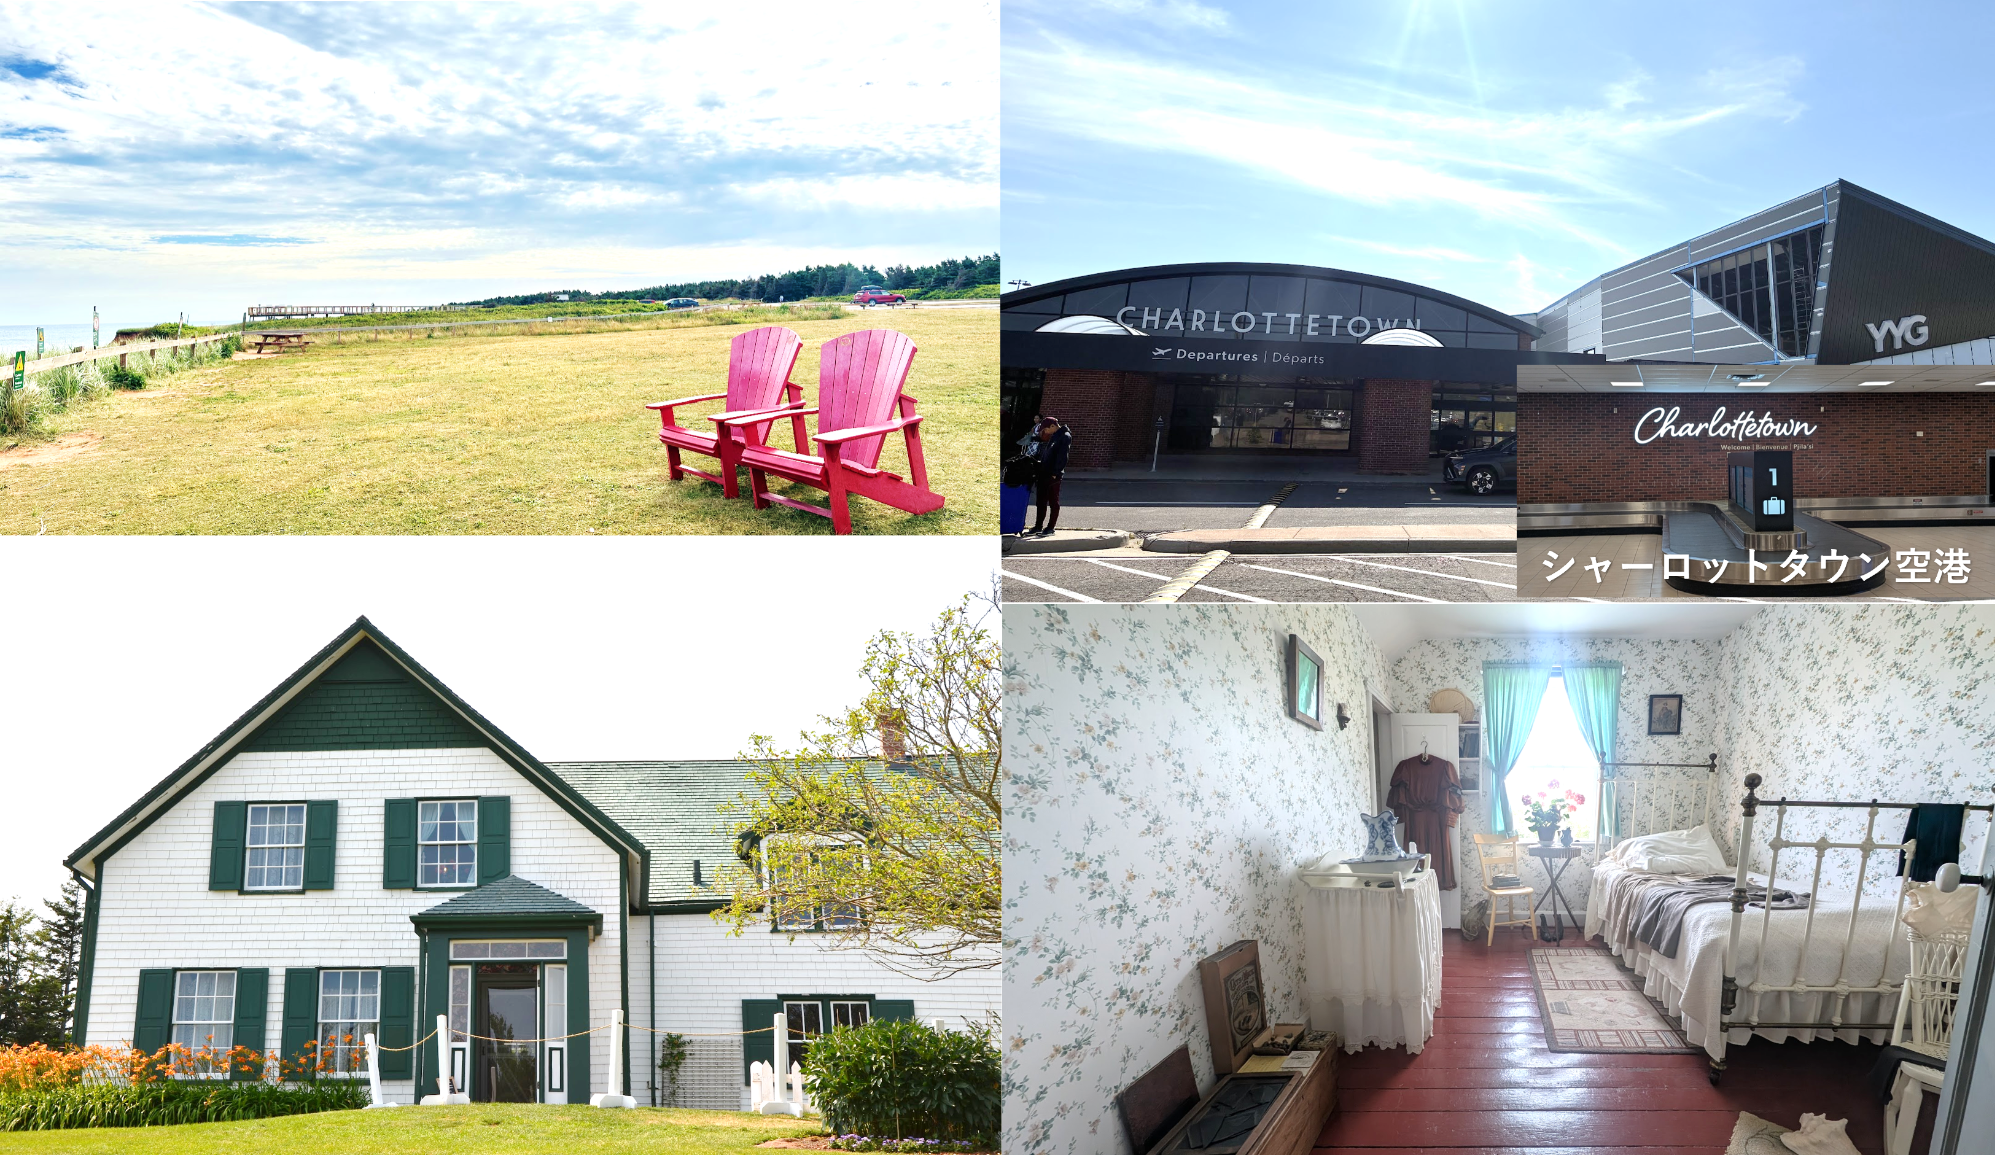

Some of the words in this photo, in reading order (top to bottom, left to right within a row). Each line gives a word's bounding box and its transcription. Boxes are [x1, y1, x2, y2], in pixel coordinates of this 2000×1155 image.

[1865, 314, 1929, 353] YYG
[1176, 348, 1258, 362] Departures
[1272, 351, 1325, 365] Départs
[1634, 406, 1817, 444] Charlottetown
[1768, 467, 1778, 486] 1
